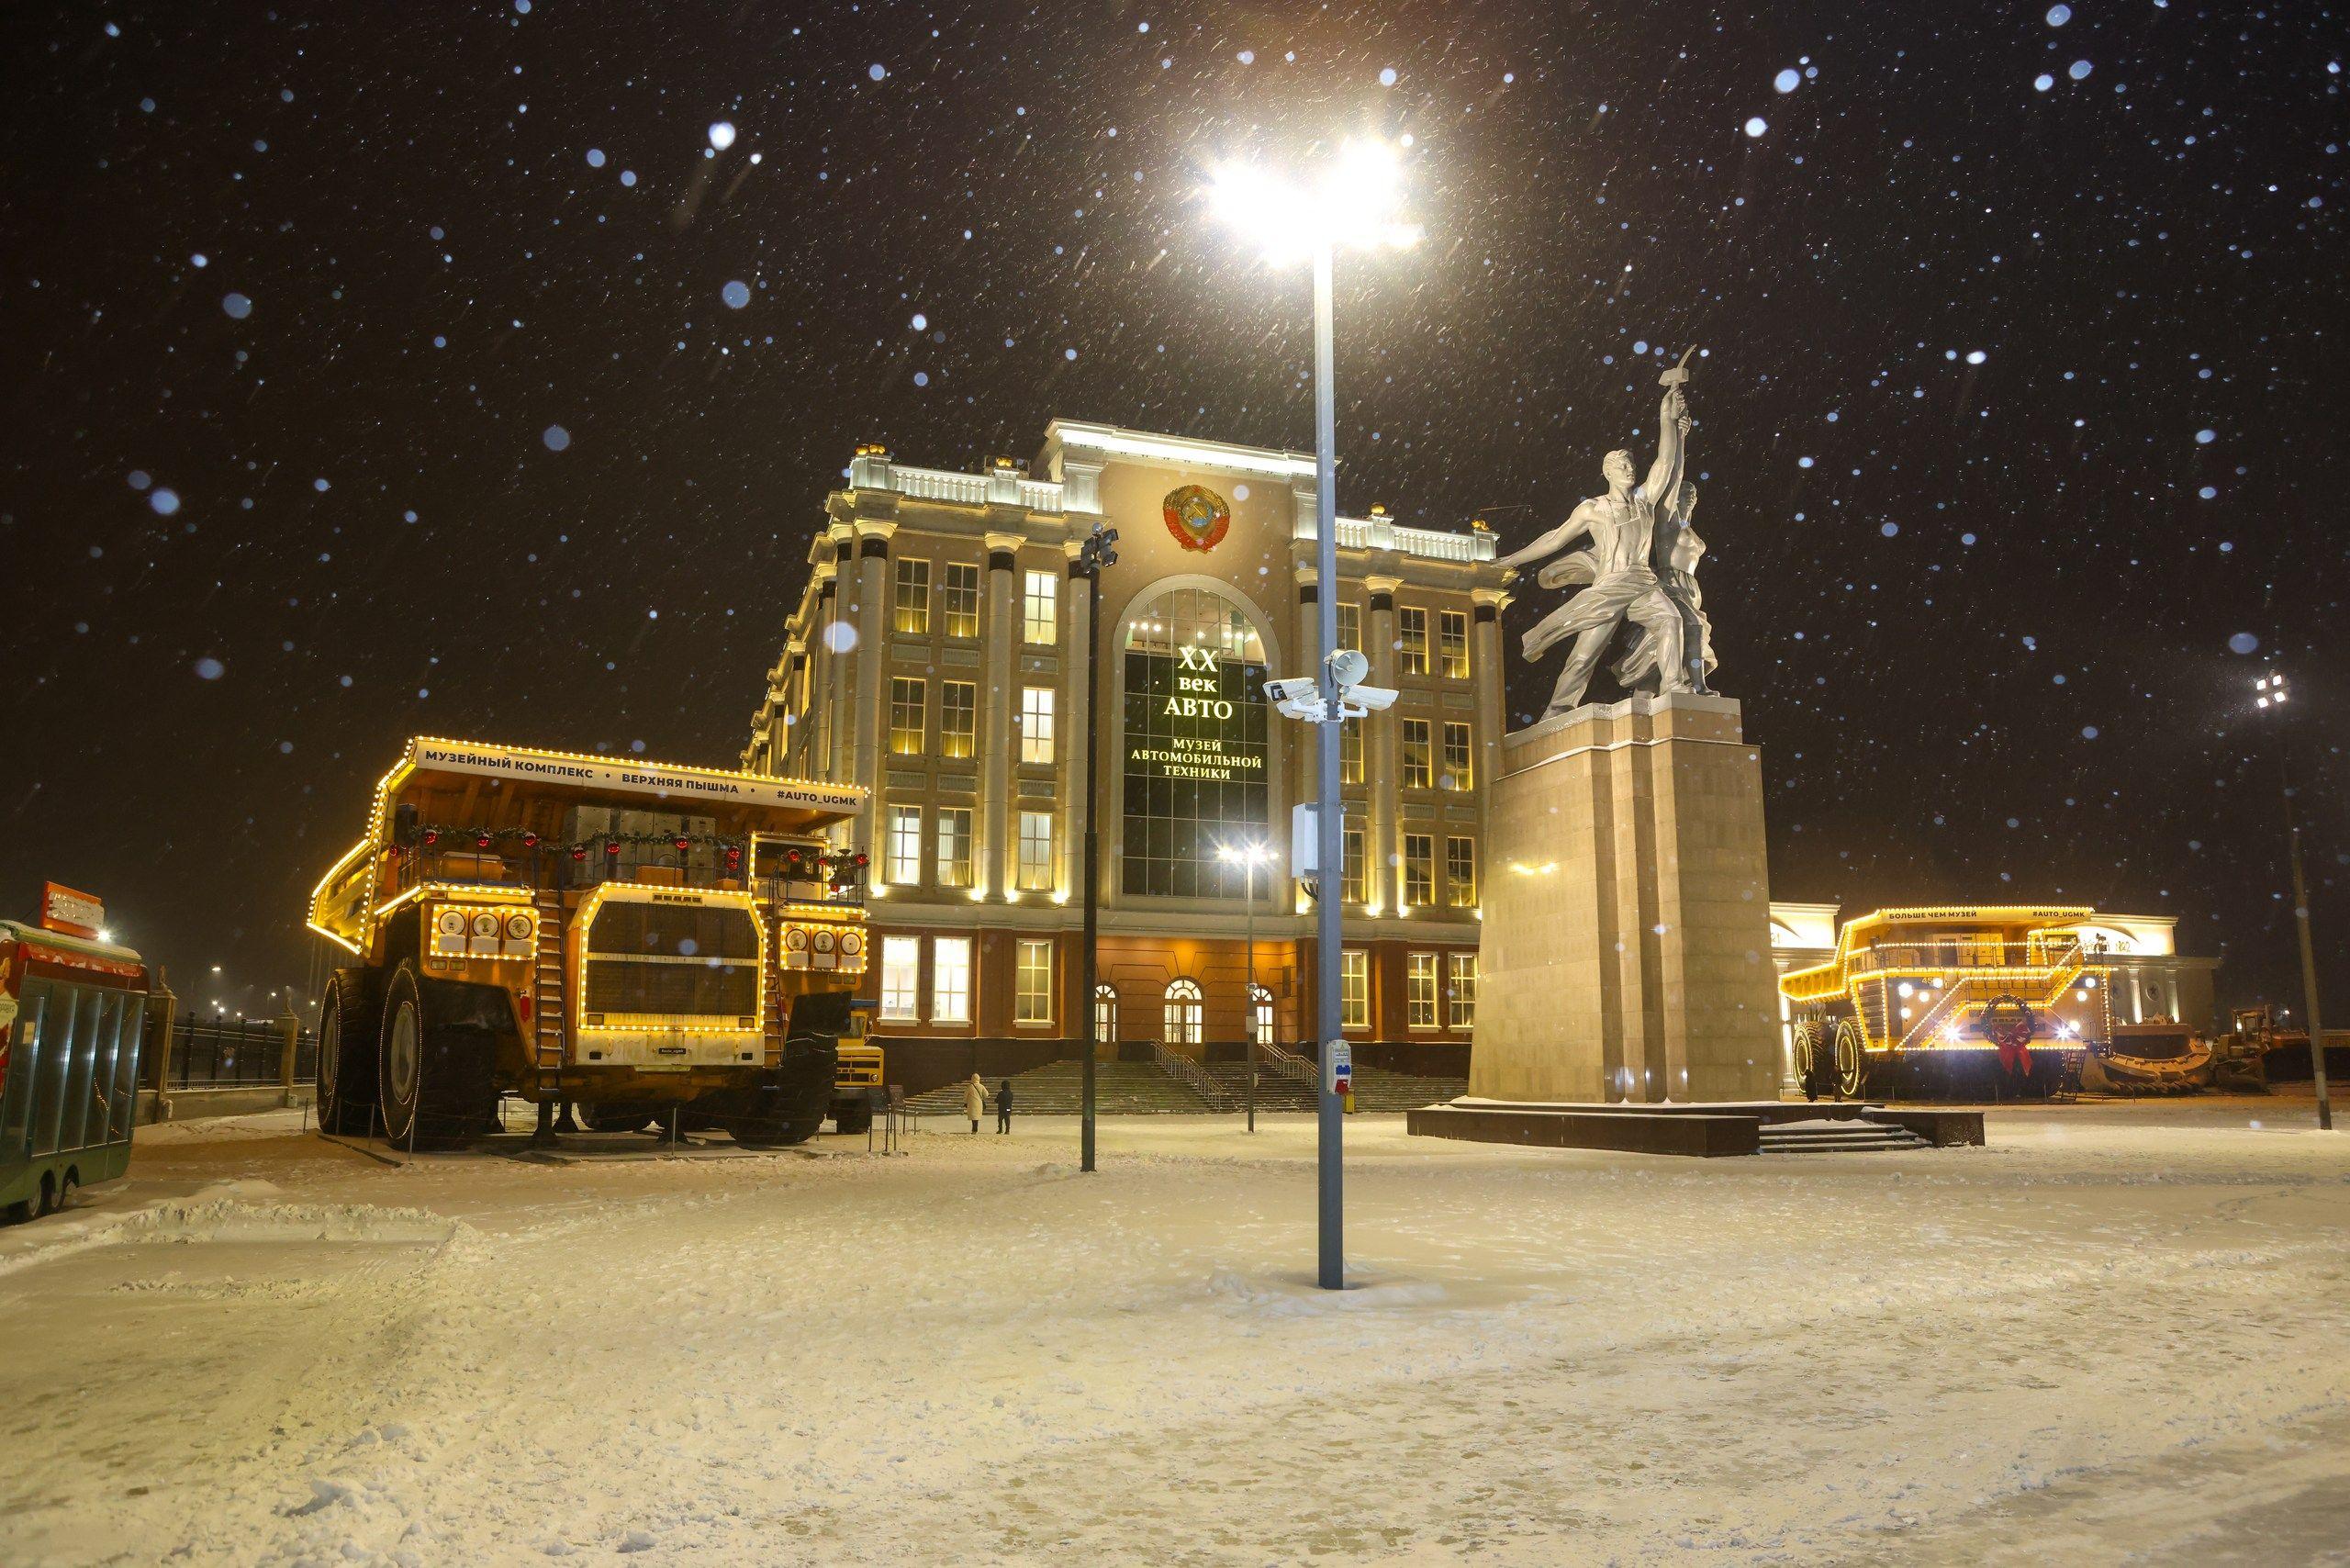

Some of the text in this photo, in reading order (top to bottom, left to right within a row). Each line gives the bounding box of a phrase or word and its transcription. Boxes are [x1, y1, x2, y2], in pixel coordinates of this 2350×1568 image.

[1179, 677, 1217, 692] век
[1163, 698, 1233, 720] АВТО
[1173, 738, 1222, 752] МУЗЕЙ
[1131, 749, 1262, 768] АВТОМОБИЛЬНОЙ
[425, 750, 857, 806] МУЗЕЙНЫЙ КОМПЛЕКС ВЕРХНЯЯ ПЫШМА #AUTO_UGMK
[1163, 765, 1231, 779] ТЕХНИКИ
